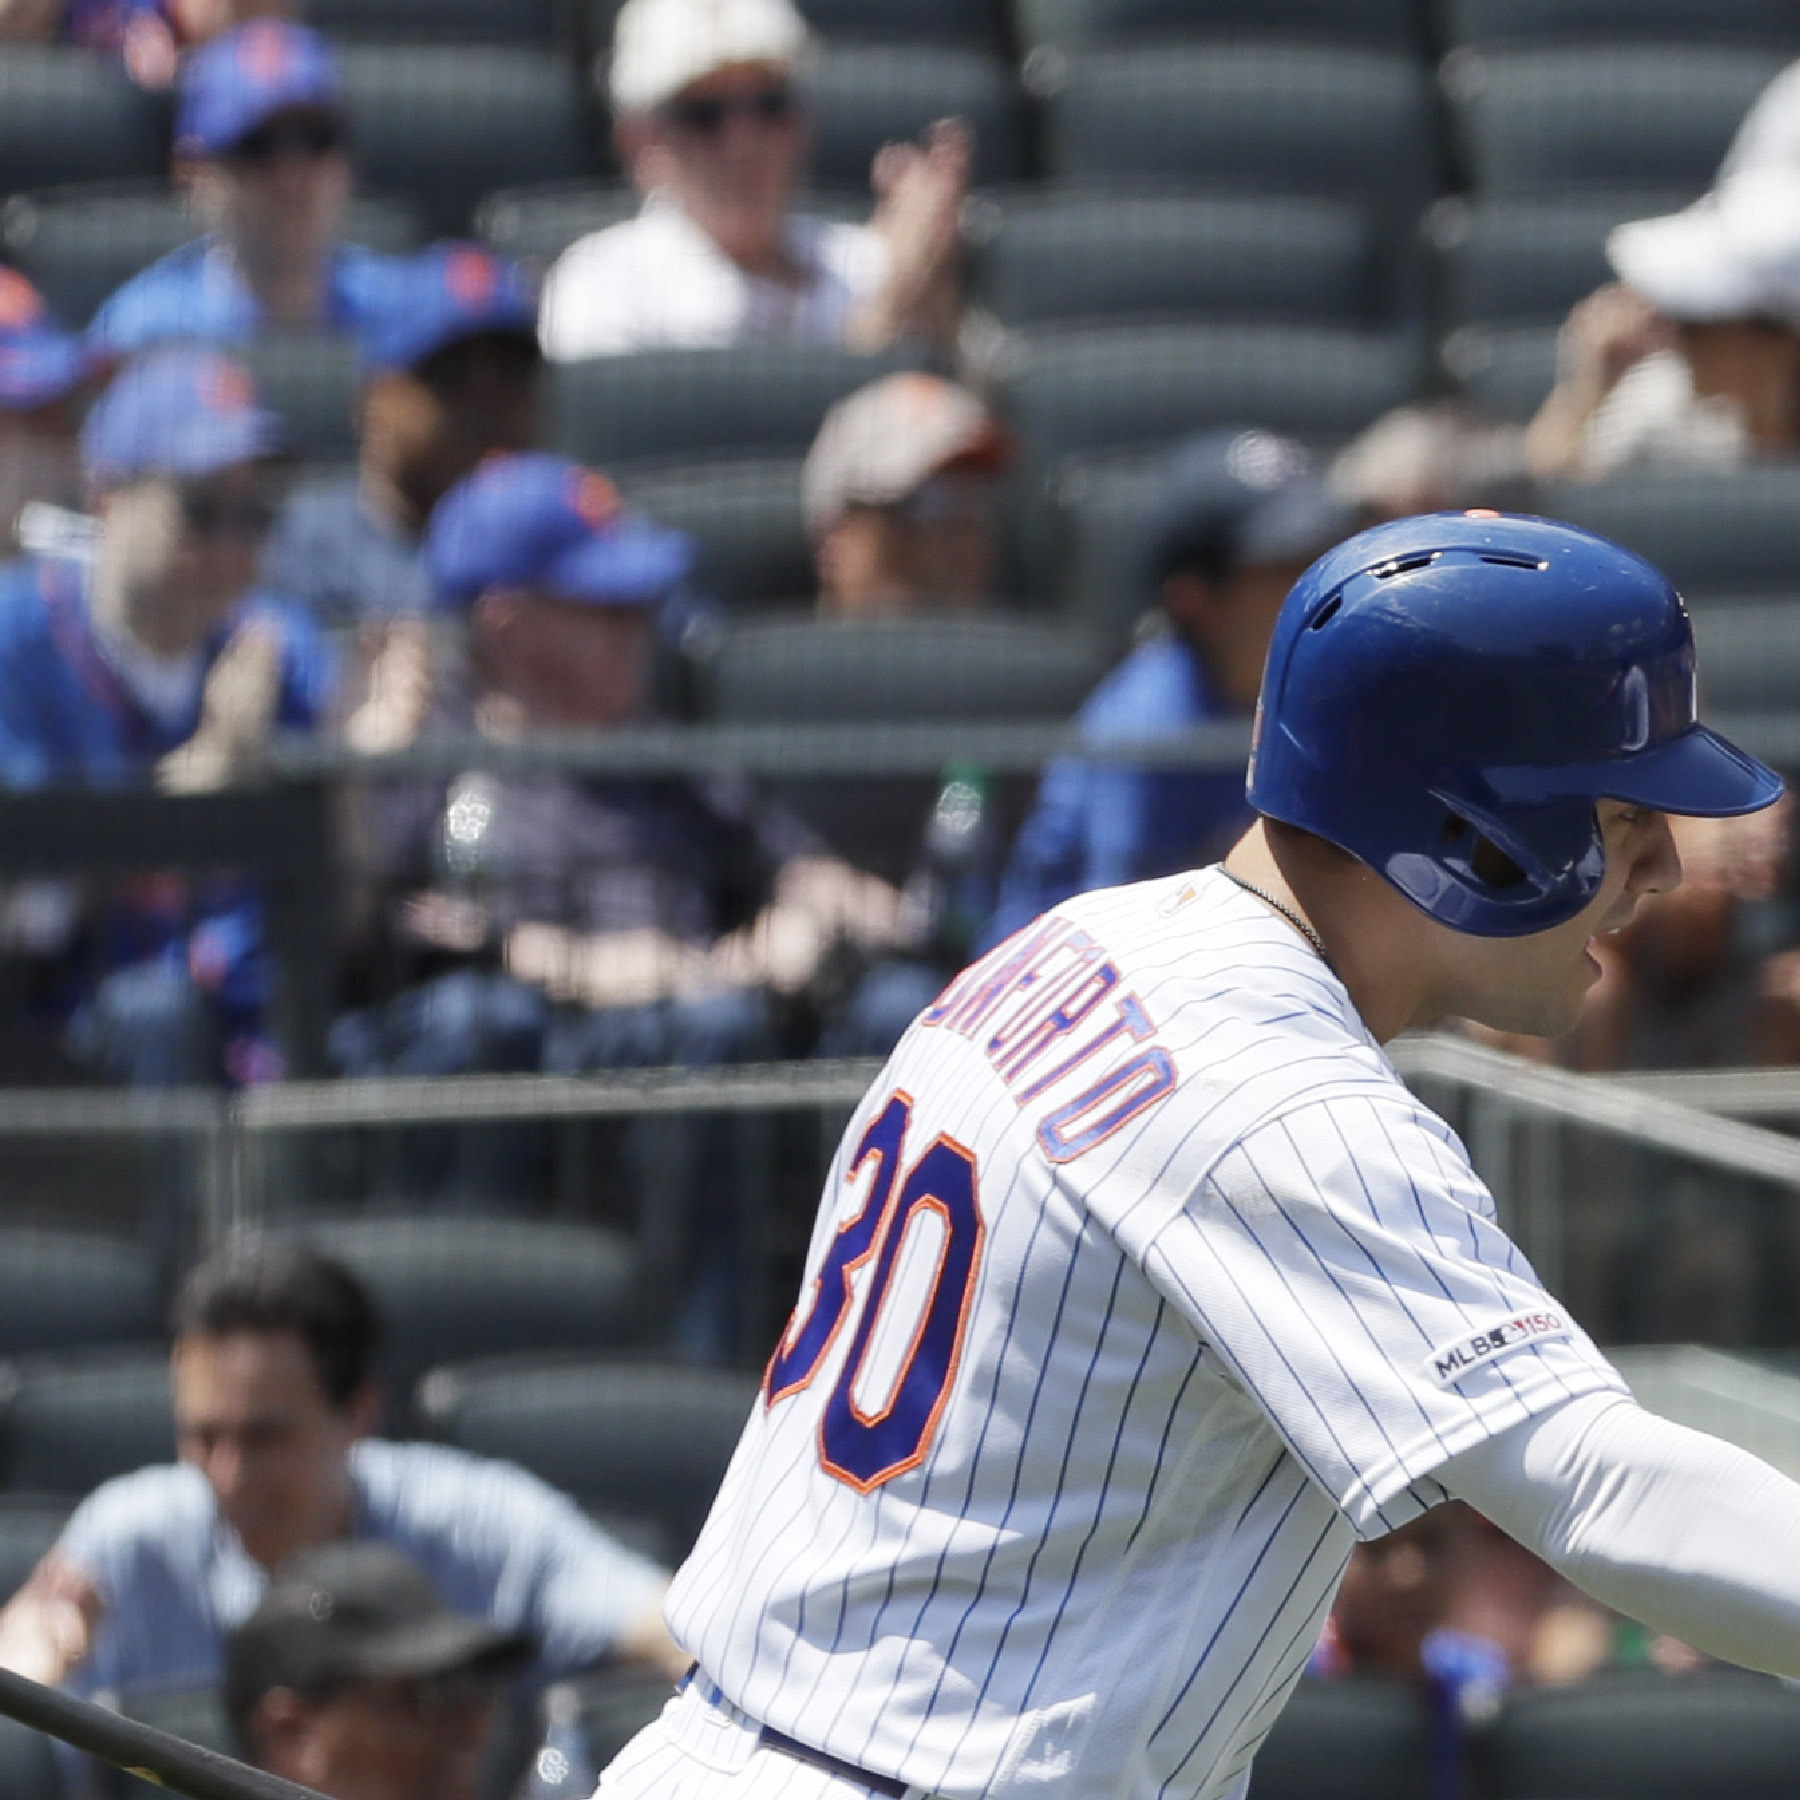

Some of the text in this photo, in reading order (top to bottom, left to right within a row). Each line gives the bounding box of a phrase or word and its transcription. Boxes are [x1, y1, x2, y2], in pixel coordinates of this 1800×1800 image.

[765, 1087, 985, 1495] 30
[1435, 1313, 1562, 1379] MLB 150
